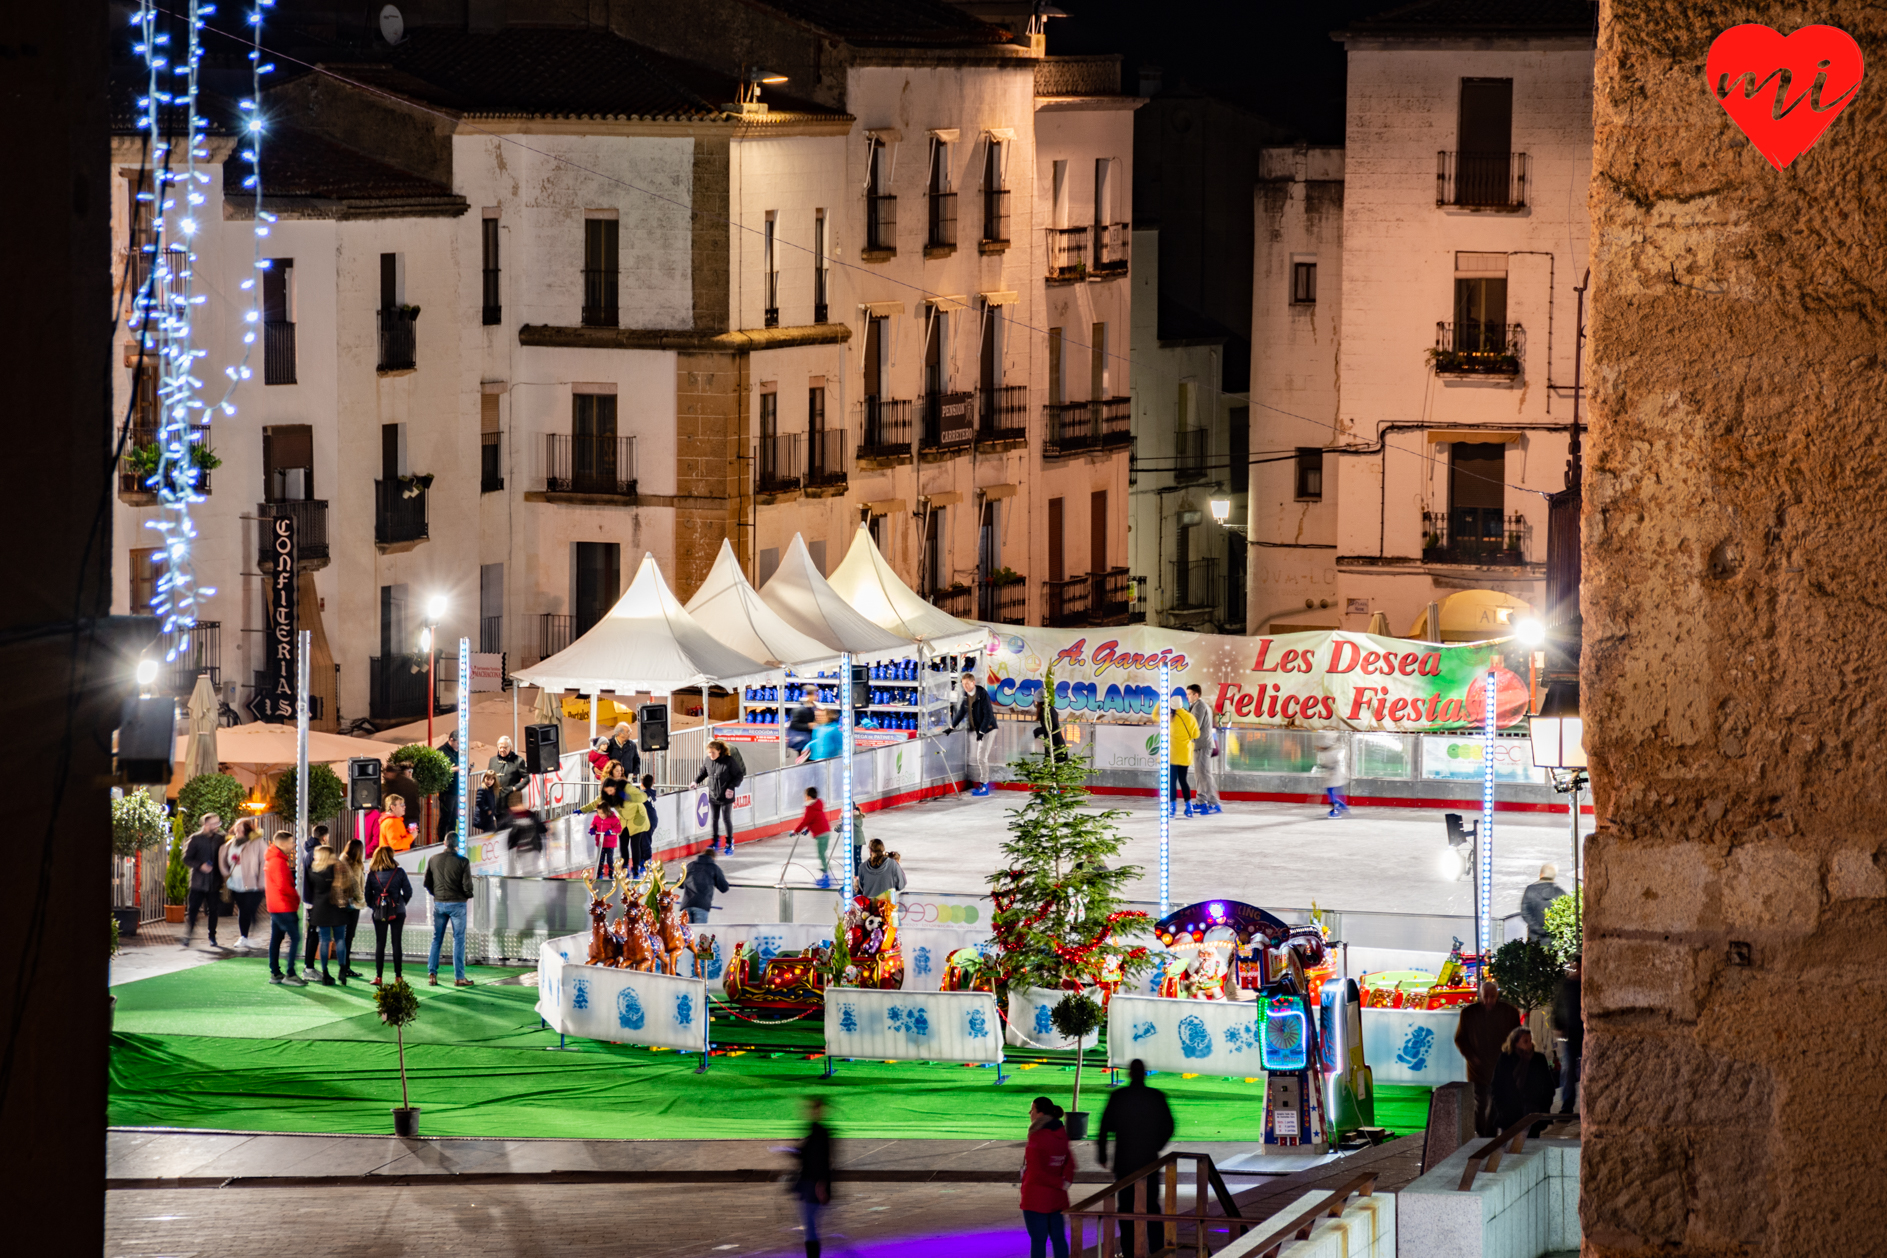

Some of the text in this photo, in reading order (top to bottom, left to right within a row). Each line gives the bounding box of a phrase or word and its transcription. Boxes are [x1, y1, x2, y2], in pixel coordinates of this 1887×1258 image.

[942, 428, 973, 443] CARRETERO
[1053, 638, 1189, 677] A. García
[1251, 638, 1442, 676] Les Desea
[567, 709, 589, 720] Portales
[996, 678, 1190, 715] CEESLANDA
[1215, 682, 1481, 722] Felices Fiestas
[1235, 905, 1261, 920] KING
